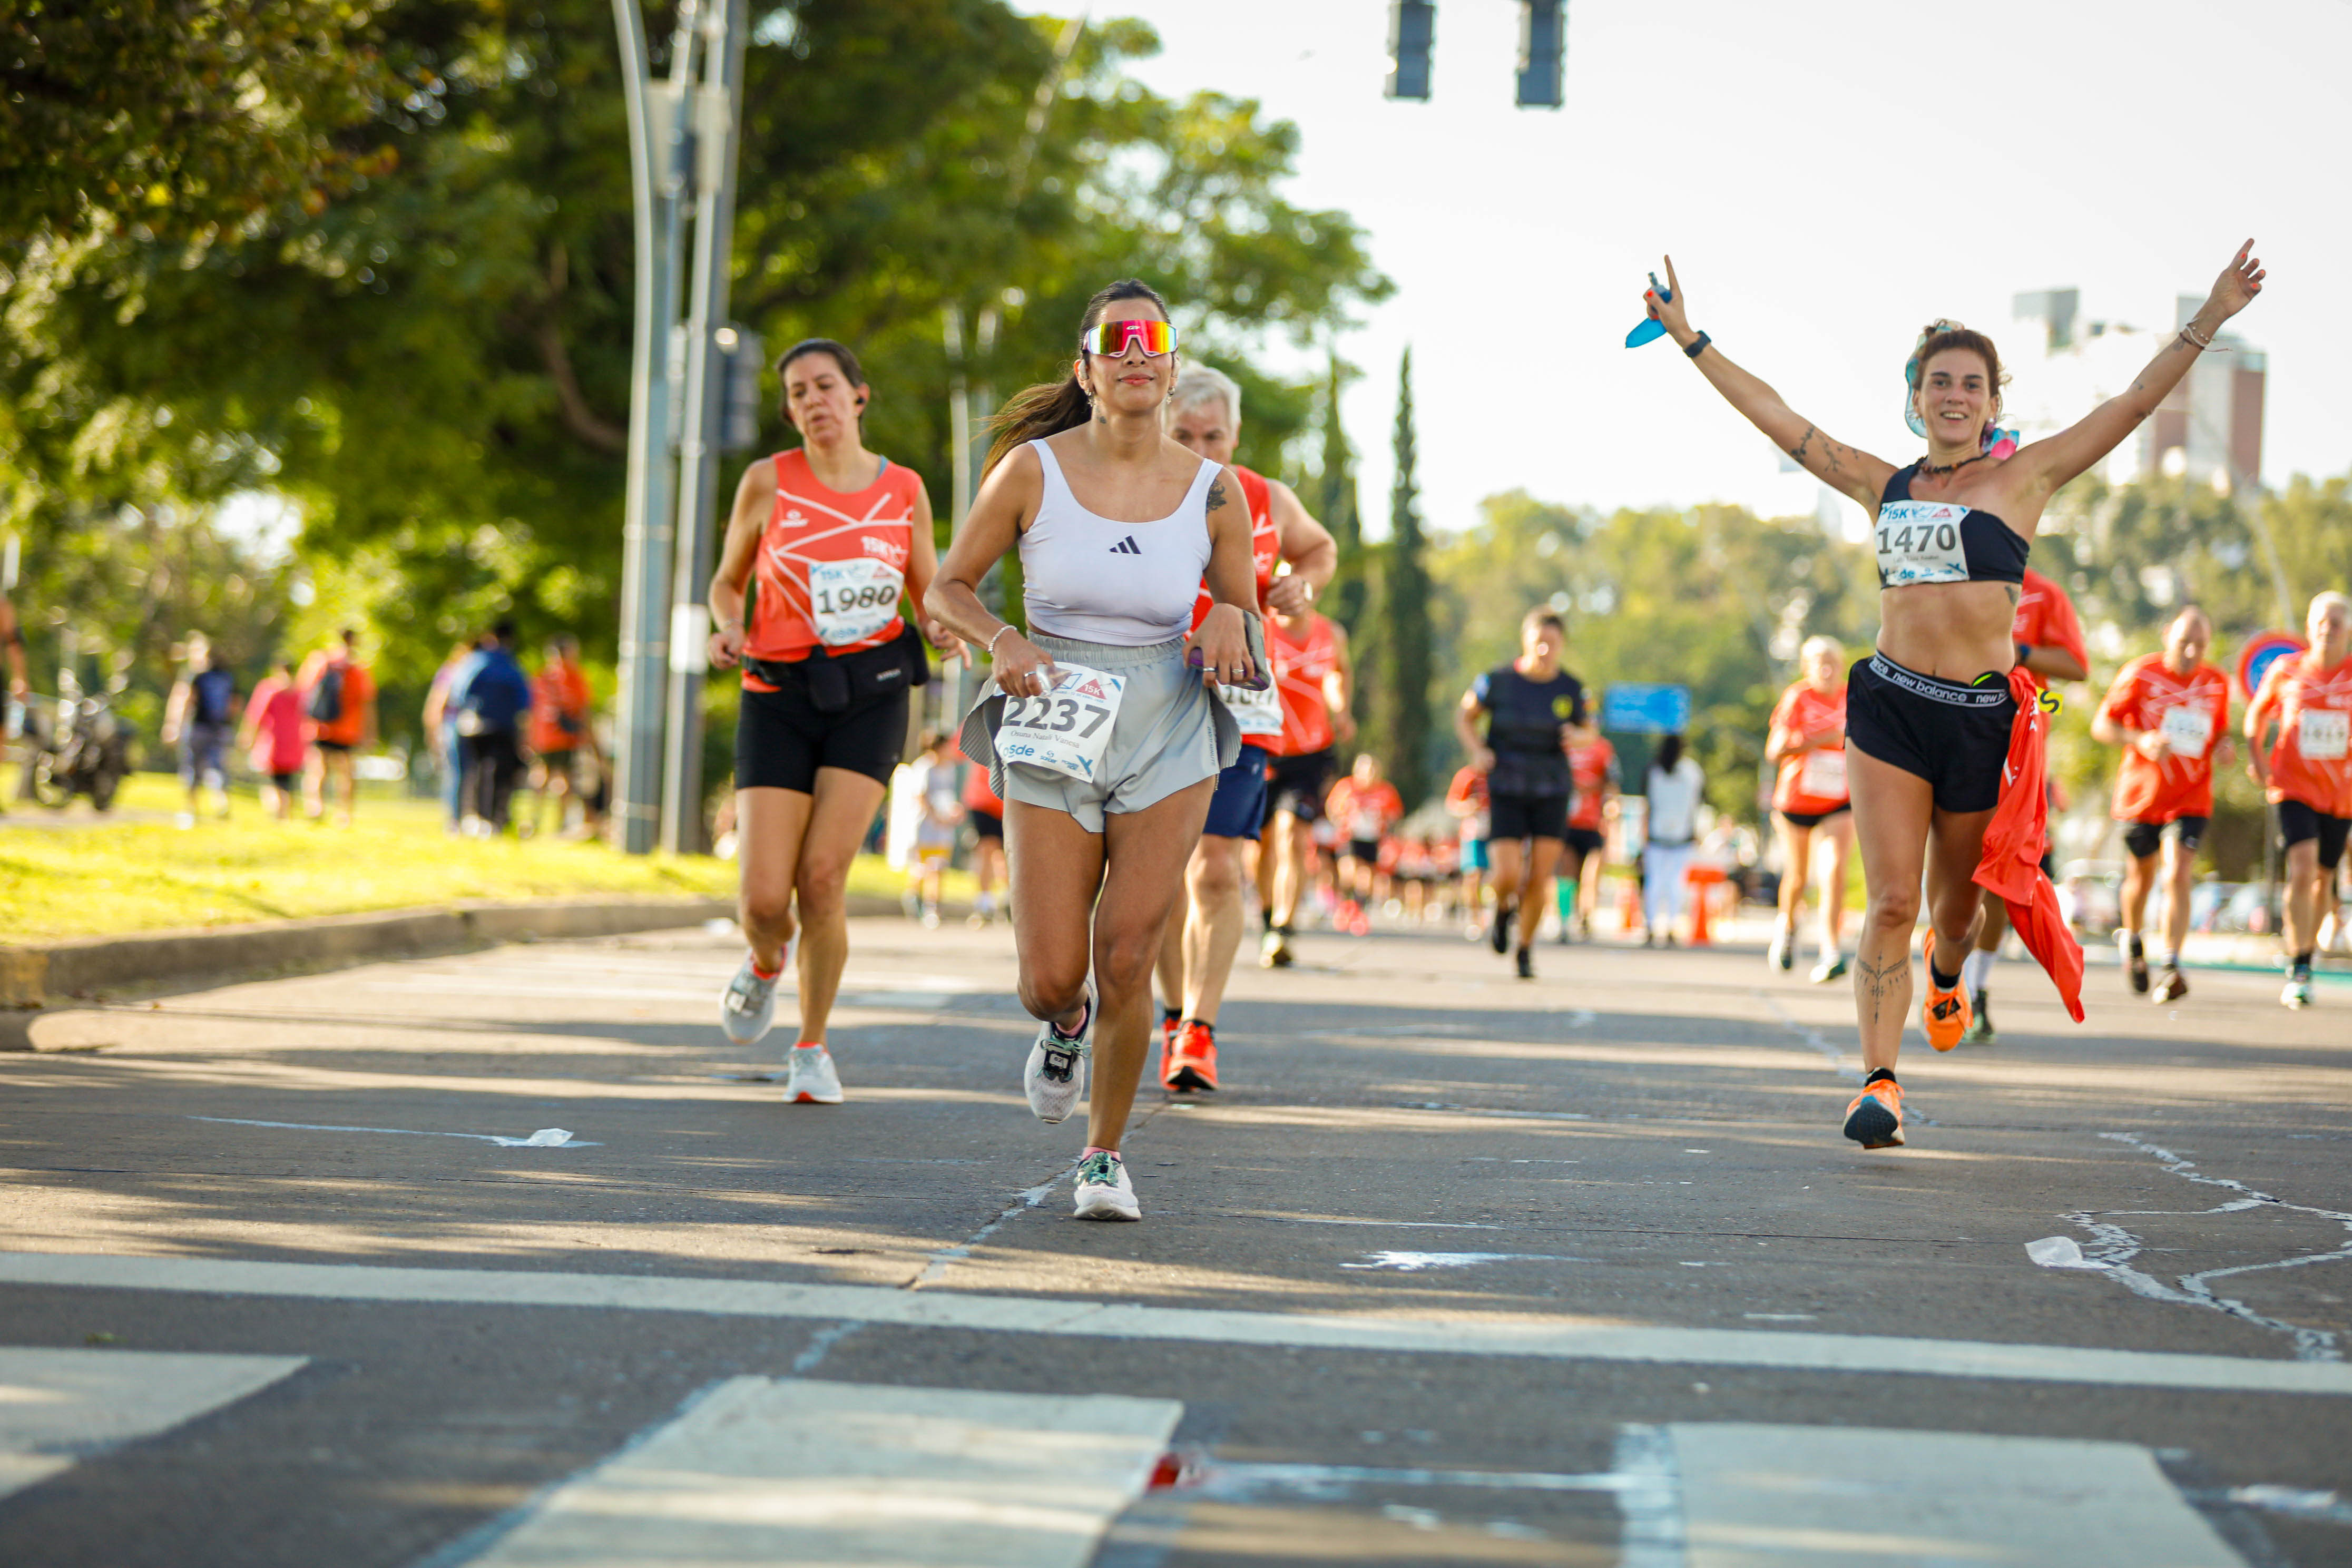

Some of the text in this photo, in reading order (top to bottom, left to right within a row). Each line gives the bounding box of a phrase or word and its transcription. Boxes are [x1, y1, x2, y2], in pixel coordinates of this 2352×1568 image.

[1888, 507, 1909, 519] 15K
[1878, 524, 1956, 554] 1470
[818, 585, 896, 614] 1980
[1085, 684, 1101, 696] 15K
[1893, 672, 1967, 702] new balance
[1976, 694, 1997, 703] new
[1001, 696, 1110, 739] 2237
[1055, 734, 1080, 749] Vanesa
[1003, 744, 1035, 758] osde
